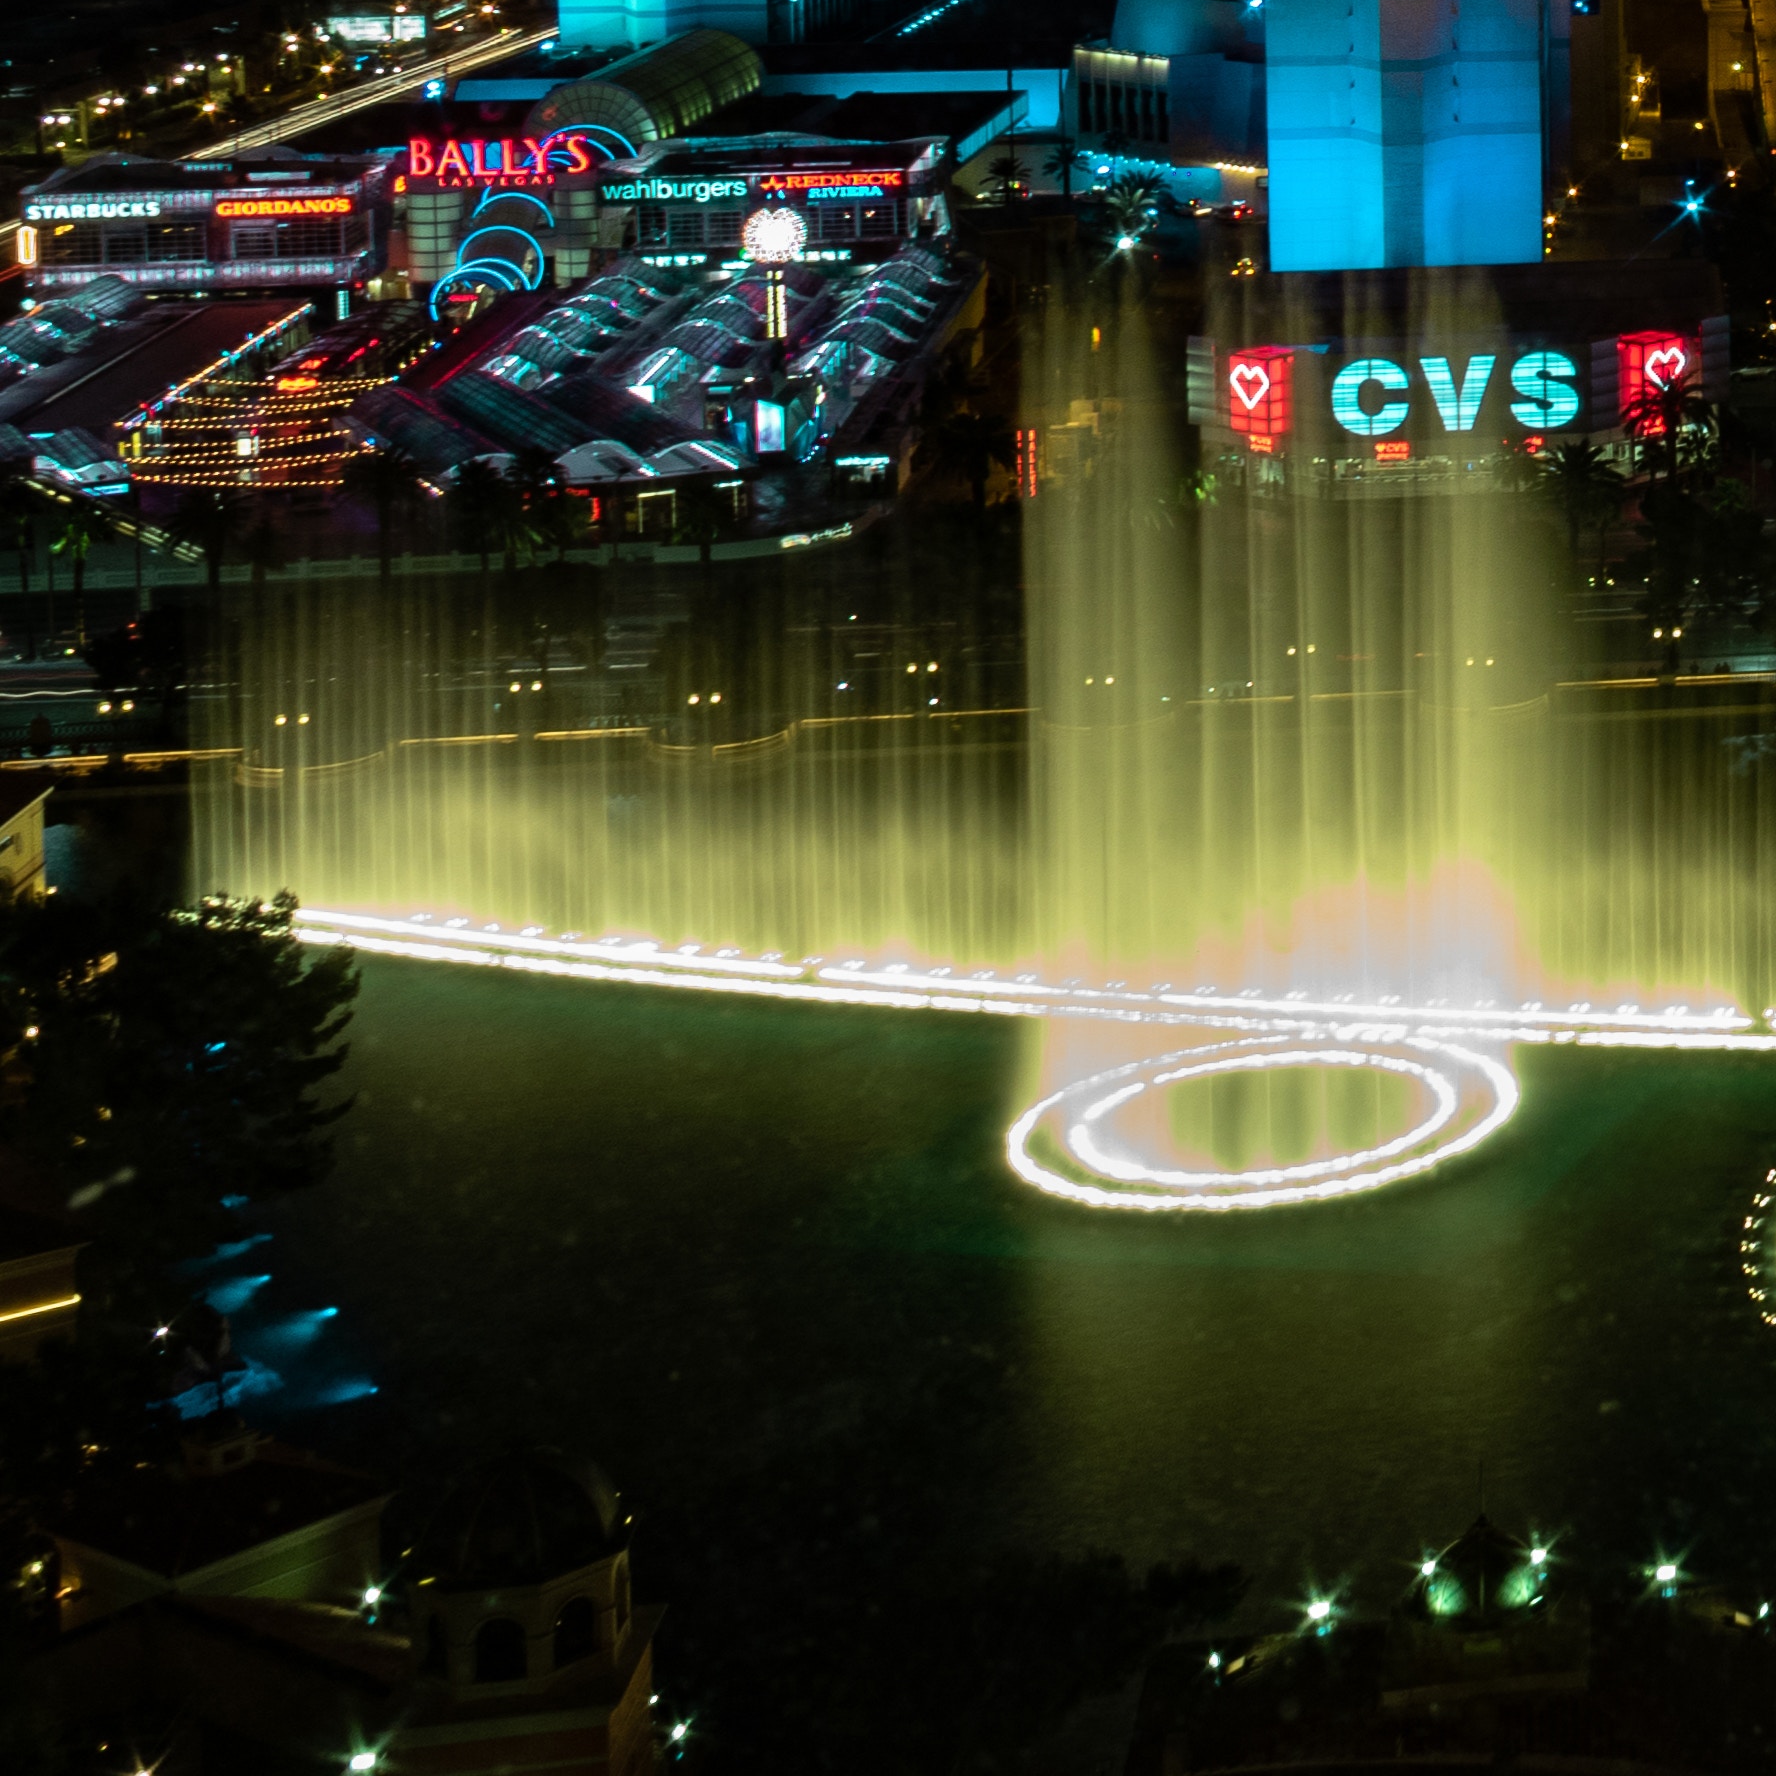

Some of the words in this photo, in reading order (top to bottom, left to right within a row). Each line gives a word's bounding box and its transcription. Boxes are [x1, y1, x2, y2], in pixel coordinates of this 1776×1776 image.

[409, 132, 590, 176] BALLY'S
[438, 176, 475, 187] LAS
[484, 174, 556, 187] VEGAS
[787, 173, 900, 189] REDNECK
[602, 179, 748, 203] wahlburgers
[808, 186, 884, 199] RIVIERA
[27, 201, 161, 220] STARBUCKS
[216, 197, 352, 217] GIORDANO'S
[1332, 351, 1579, 436] CVS
